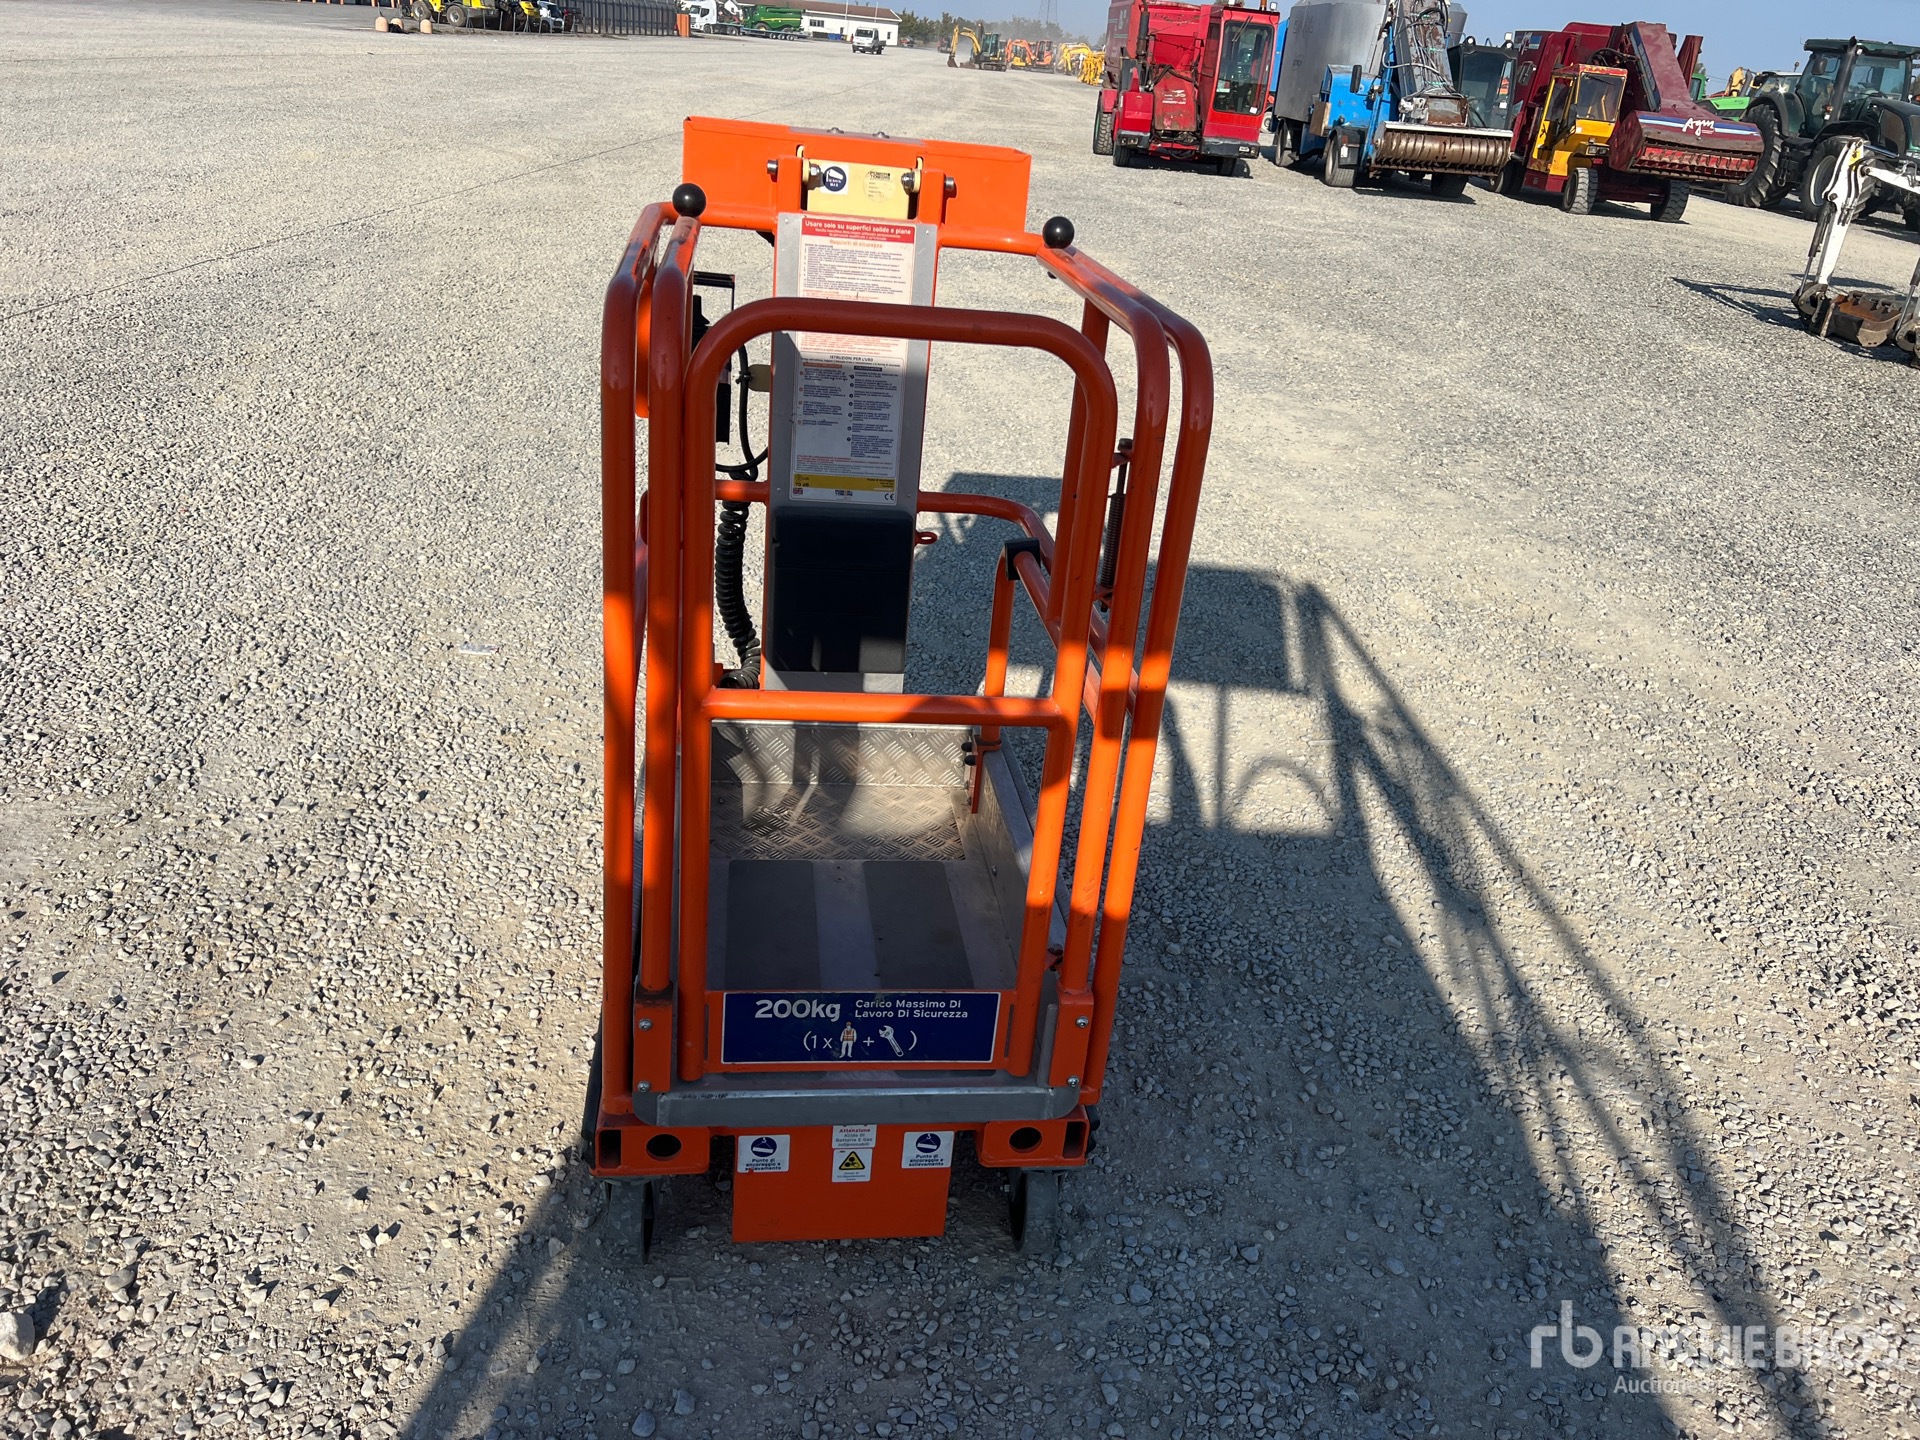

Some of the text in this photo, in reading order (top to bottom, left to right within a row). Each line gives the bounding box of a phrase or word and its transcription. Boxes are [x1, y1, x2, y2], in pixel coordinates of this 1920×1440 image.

[805, 220, 822, 228] Usare
[846, 223, 872, 231] superfici
[855, 999, 961, 1008] Carico Massimo Di
[755, 999, 841, 1022] 200kg
[855, 1010, 968, 1018] Lavoro Di Sicurezza
